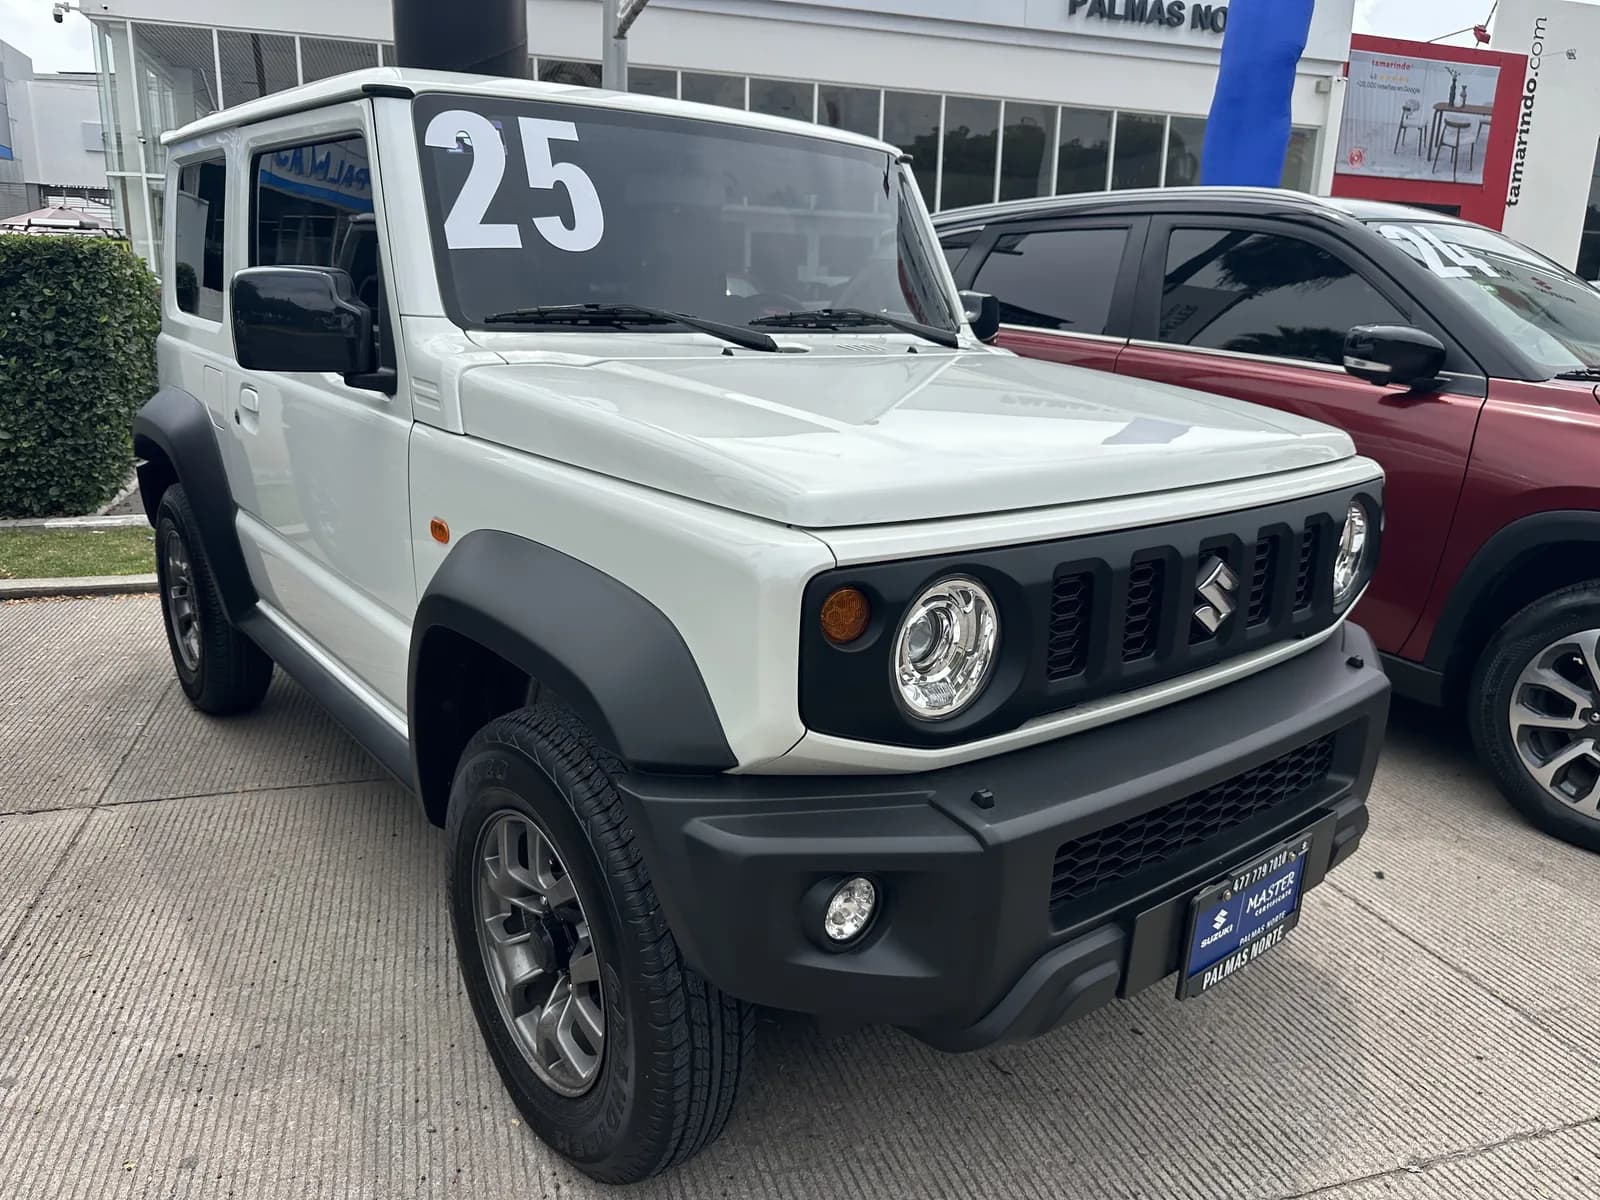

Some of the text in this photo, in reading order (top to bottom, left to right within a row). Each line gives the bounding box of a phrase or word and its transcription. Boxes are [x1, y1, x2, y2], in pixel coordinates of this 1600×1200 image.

[1067, 0, 1186, 27] PALMAS
[1371, 59, 1412, 70] tamarindo
[1505, 16, 1547, 208] tamarindo.com
[424, 109, 605, 252] 25
[1378, 224, 1501, 279] 24
[1232, 873, 1251, 892] 477
[1251, 862, 1268, 883] 779
[1246, 871, 1296, 914] MASTER
[1200, 923, 1234, 949] SUZUKI
[1238, 910, 1287, 947] PALMAS NORTE
[1202, 924, 1284, 991] PALMAS NORTE
